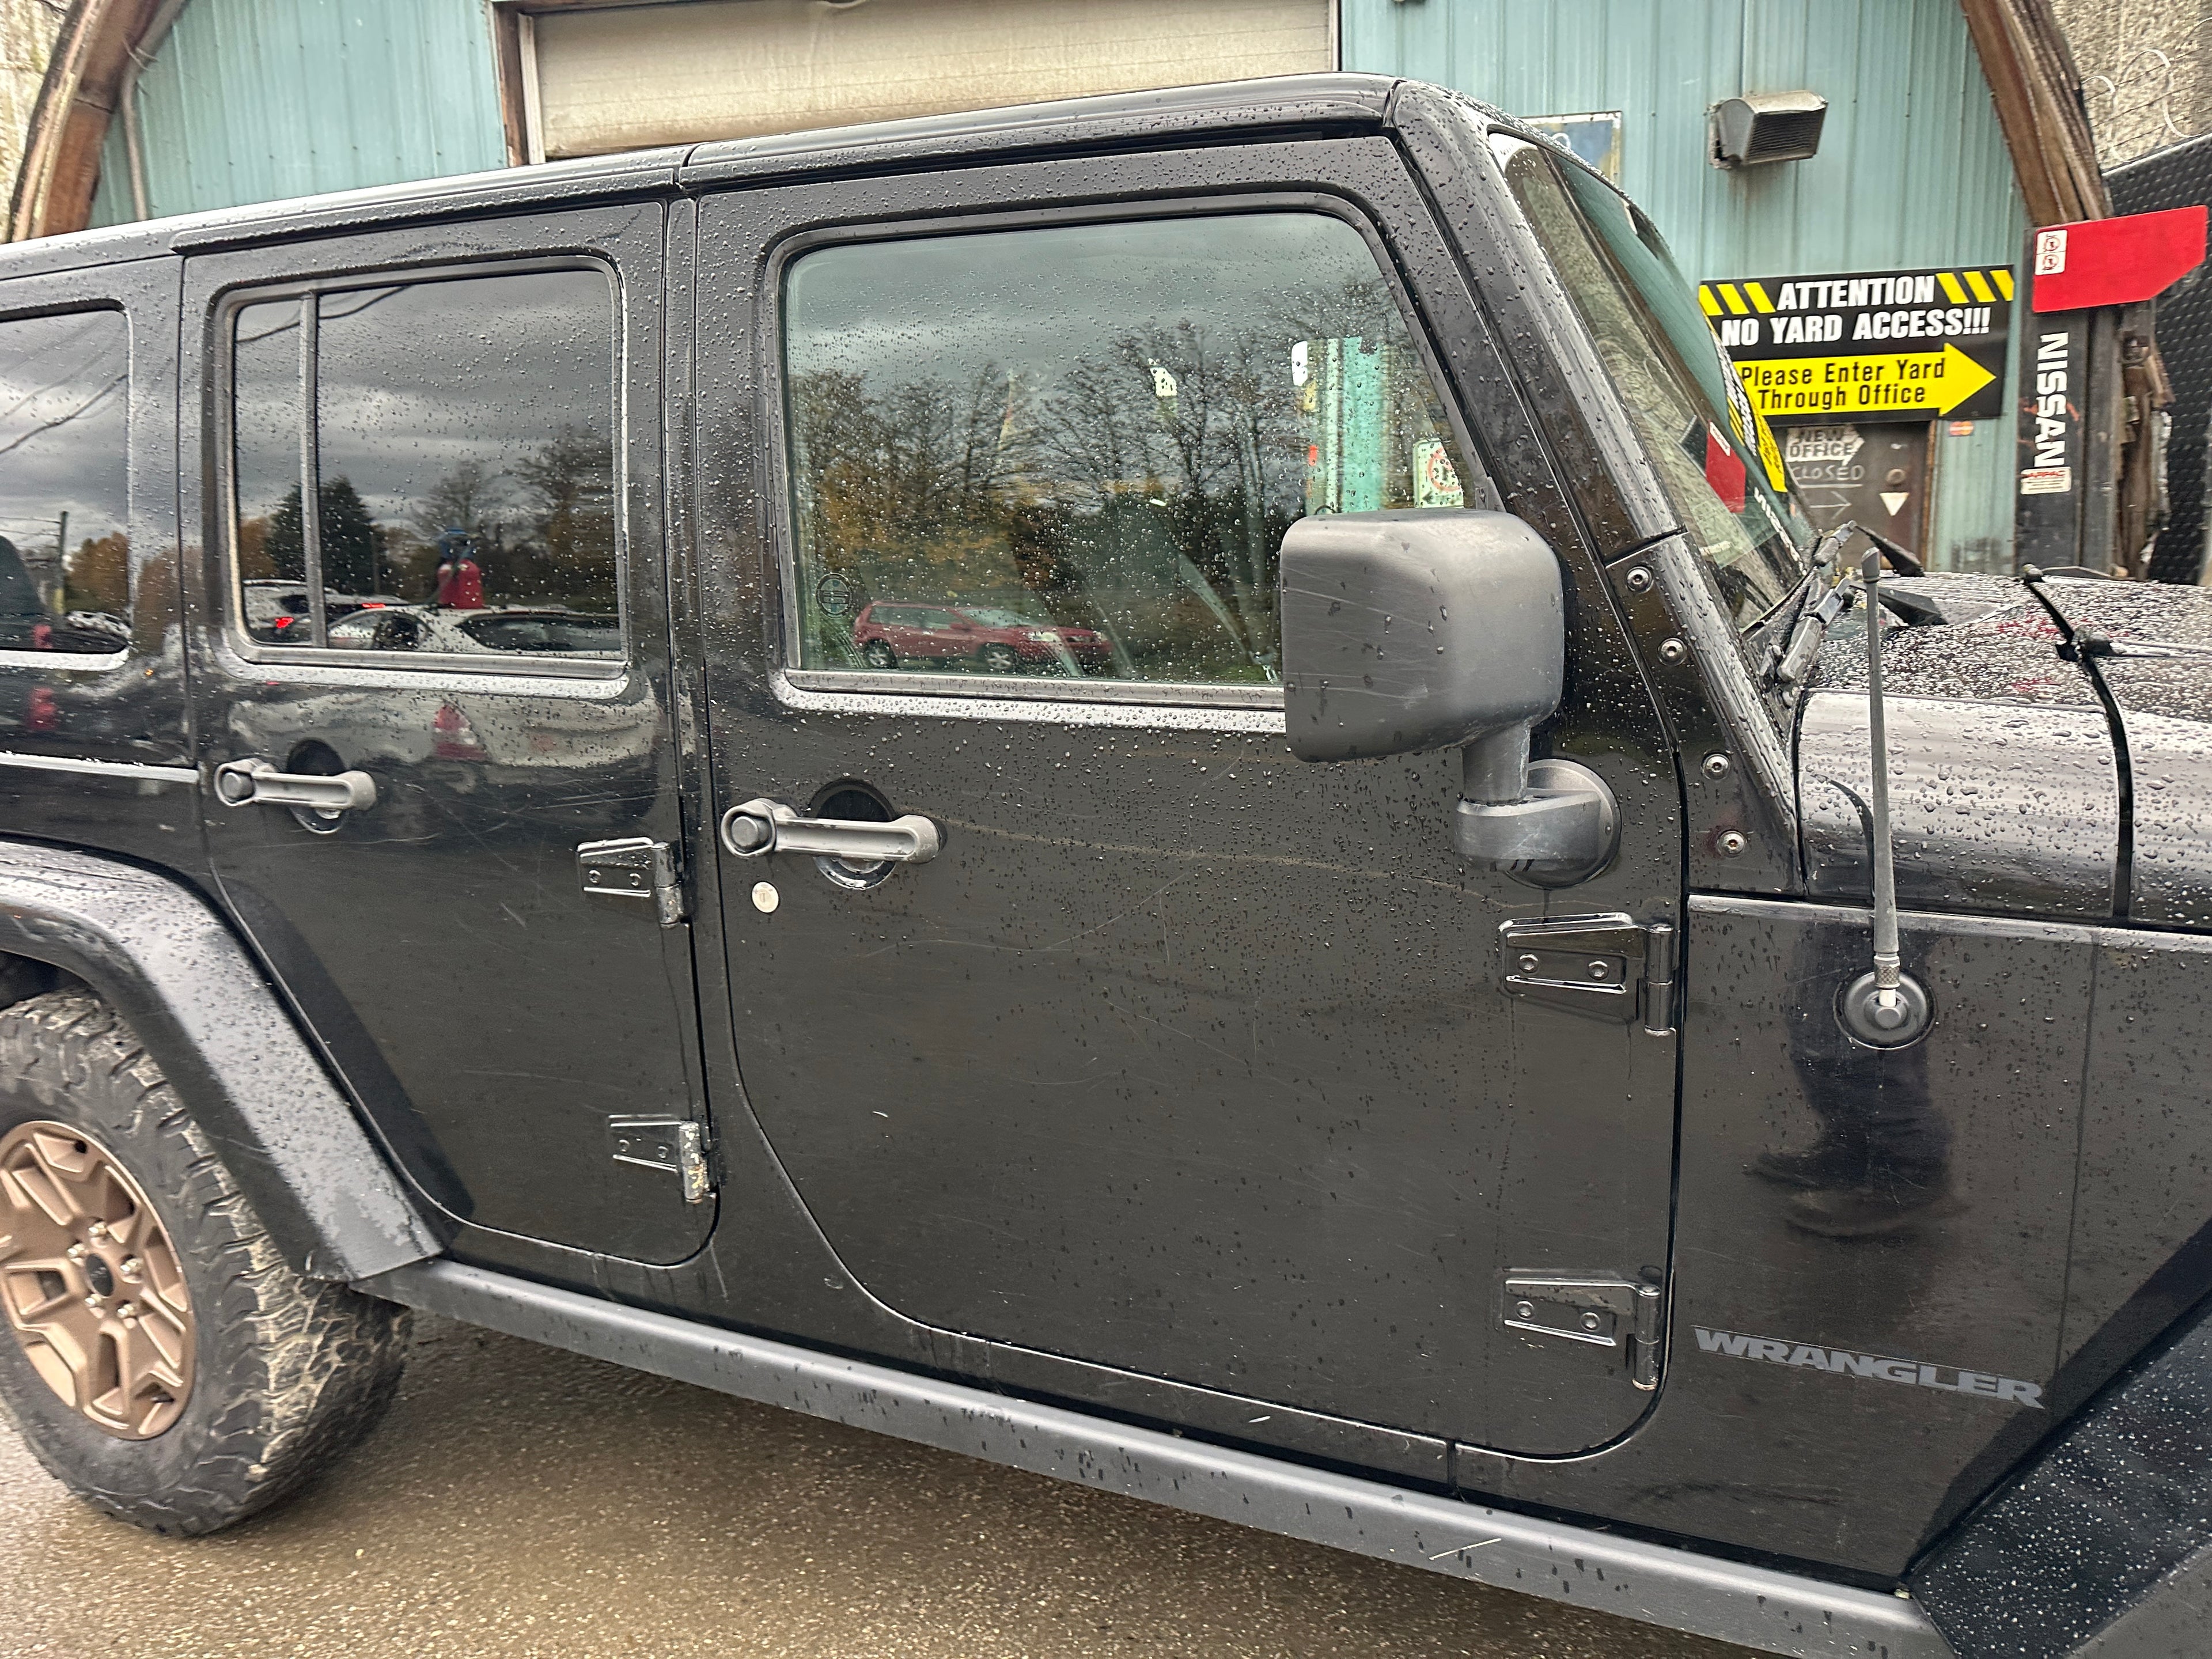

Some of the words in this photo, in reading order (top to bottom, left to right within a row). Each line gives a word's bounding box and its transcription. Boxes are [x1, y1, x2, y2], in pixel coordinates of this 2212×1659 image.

[1777, 275, 1935, 310] ATTENTION
[1721, 318, 1759, 347] NO
[1769, 314, 1843, 344] YARD
[1852, 307, 1991, 340] ACCESS!!!
[1741, 367, 1813, 388] Please
[1824, 362, 1885, 383] Enter
[1896, 357, 1946, 380] Yard
[1757, 387, 1846, 410] Through
[1858, 382, 1926, 404] Office
[2034, 332, 2069, 467] NISSAN
[1790, 442, 1854, 457] OFFICE
[1791, 464, 1865, 480] CLOSED
[1693, 1327, 2046, 1410] WRANGLER
